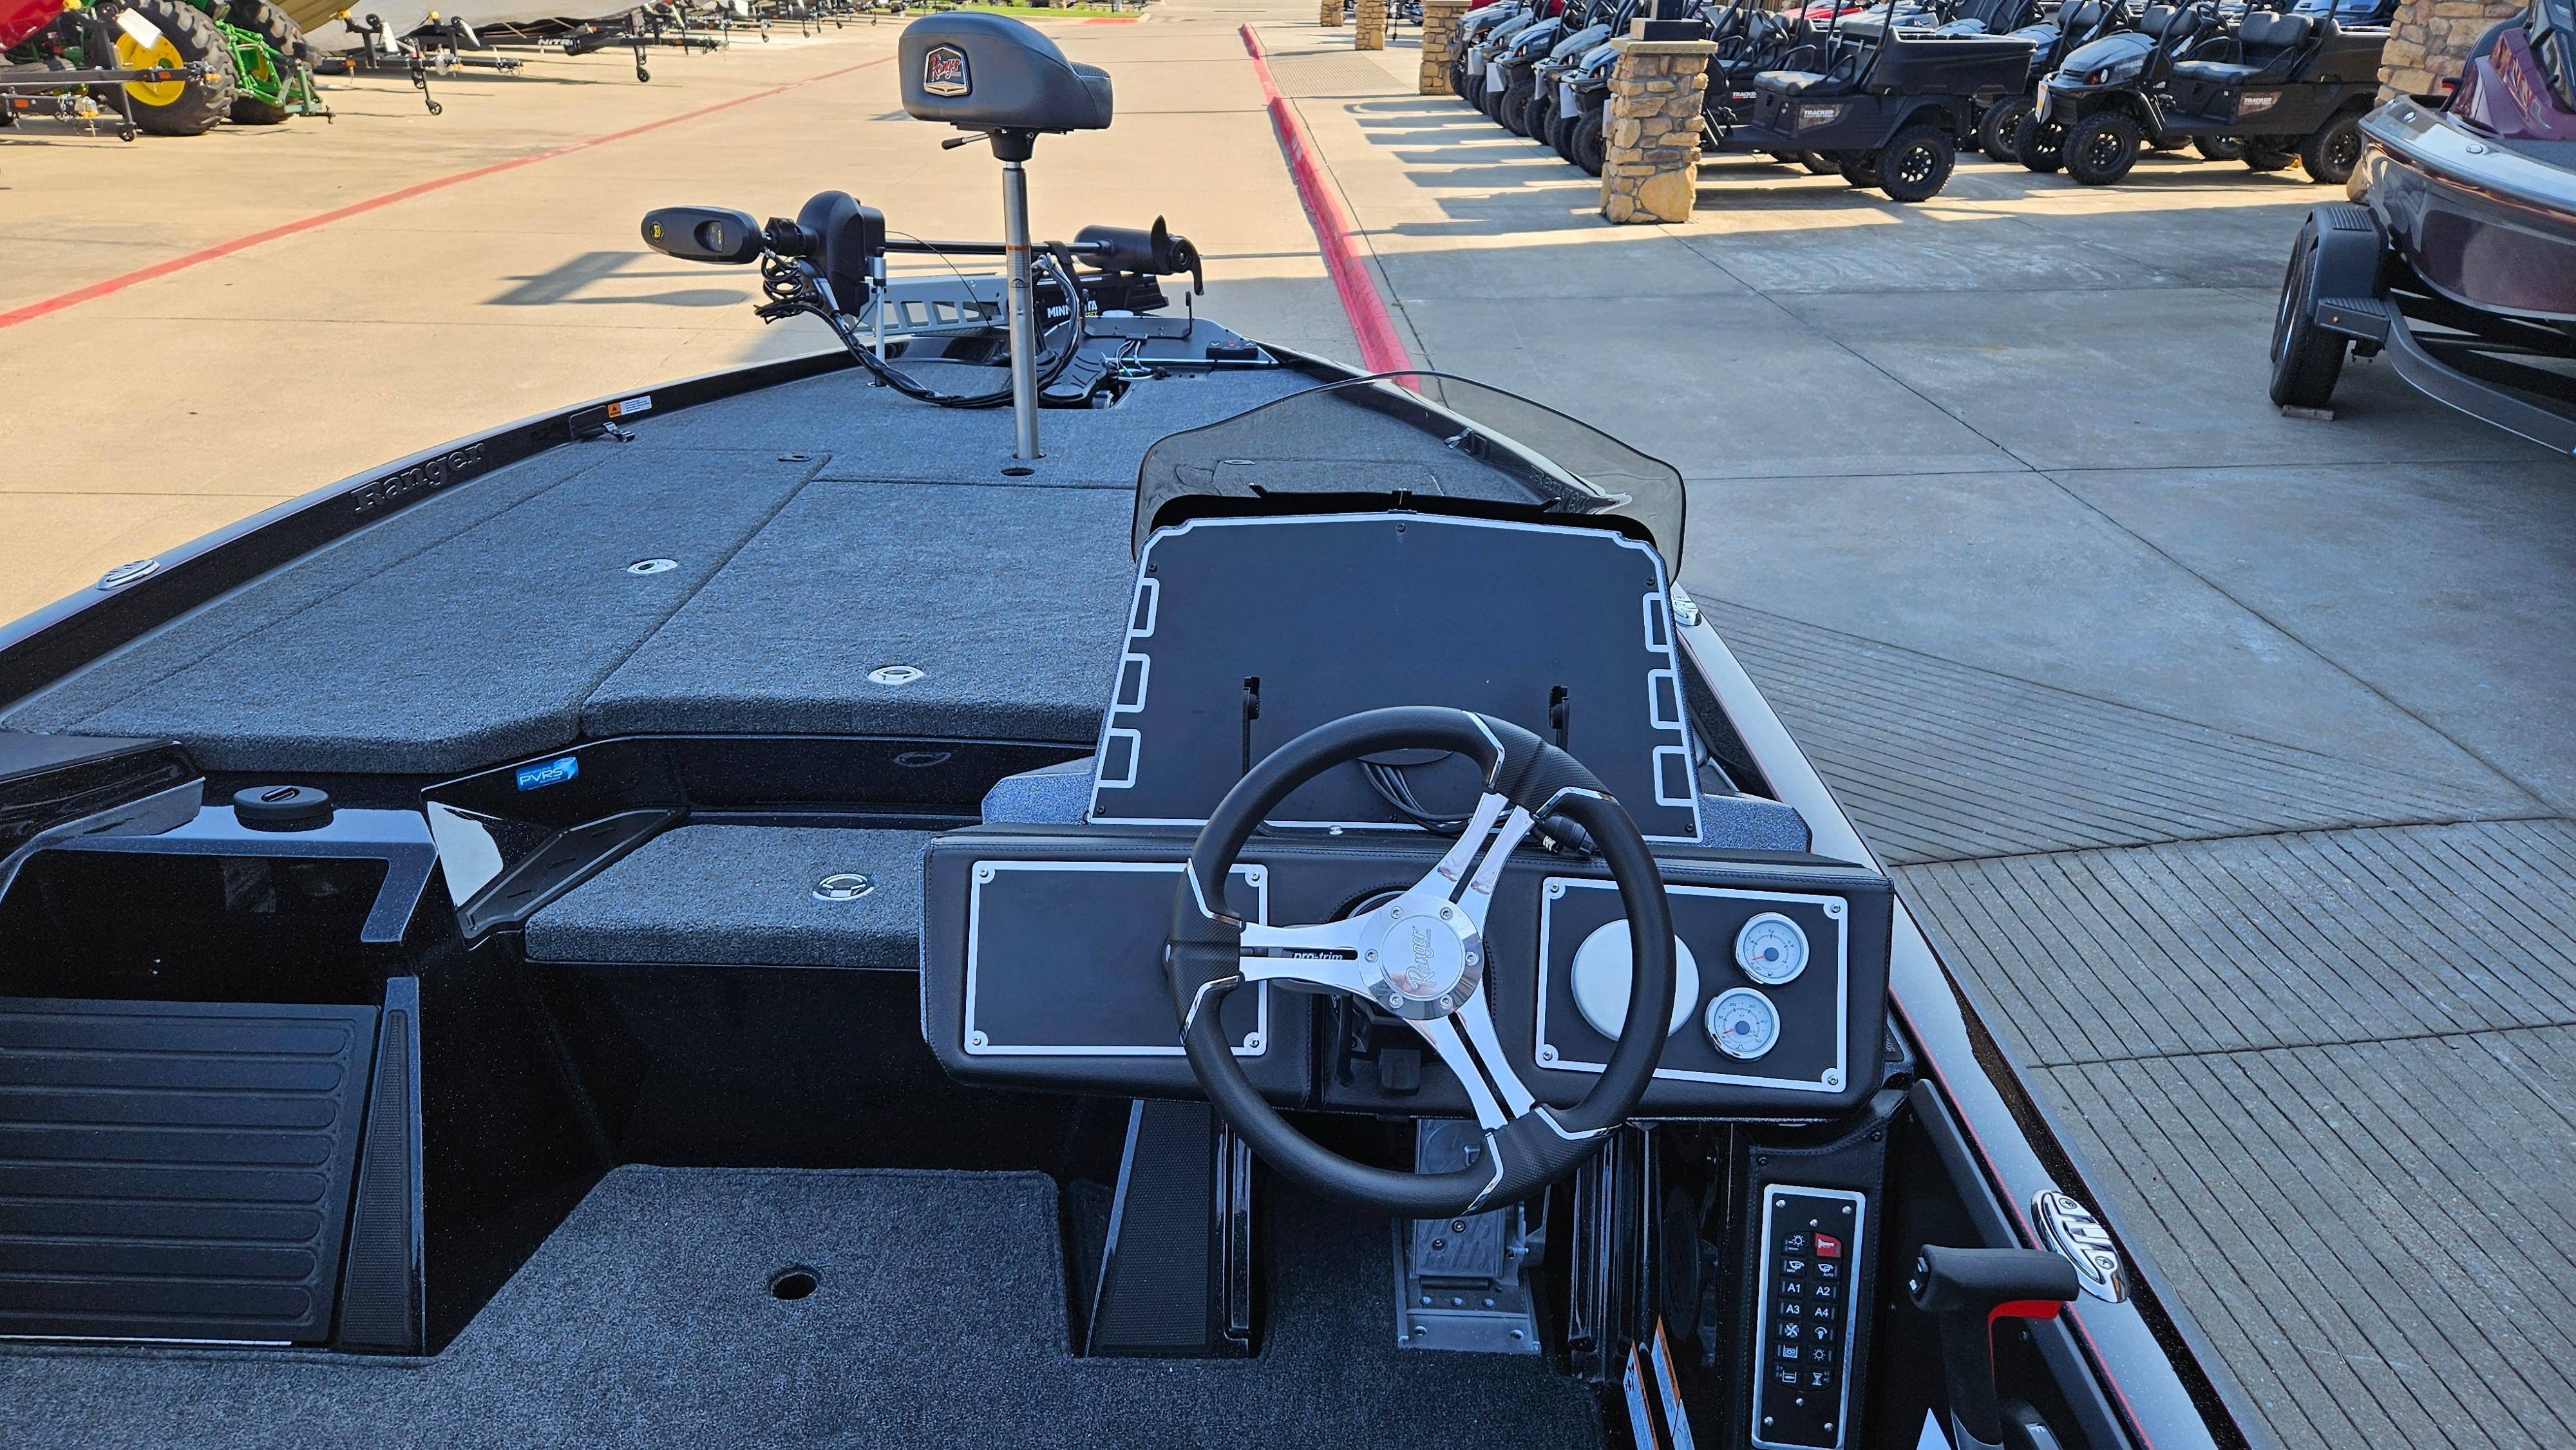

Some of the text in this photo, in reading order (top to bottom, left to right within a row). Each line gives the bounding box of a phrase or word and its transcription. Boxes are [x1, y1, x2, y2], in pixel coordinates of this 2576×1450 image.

[929, 53, 961, 82] Ranger
[351, 442, 485, 511] Ranger
[519, 769, 563, 786] PVRS
[1294, 952, 1343, 960] pro-trim
[1405, 928, 1437, 990] Ranger
[1787, 1283, 1801, 1293] A1
[1816, 1286, 1830, 1295] A2
[1786, 1304, 1800, 1314] A3
[1814, 1307, 1828, 1317] A4
